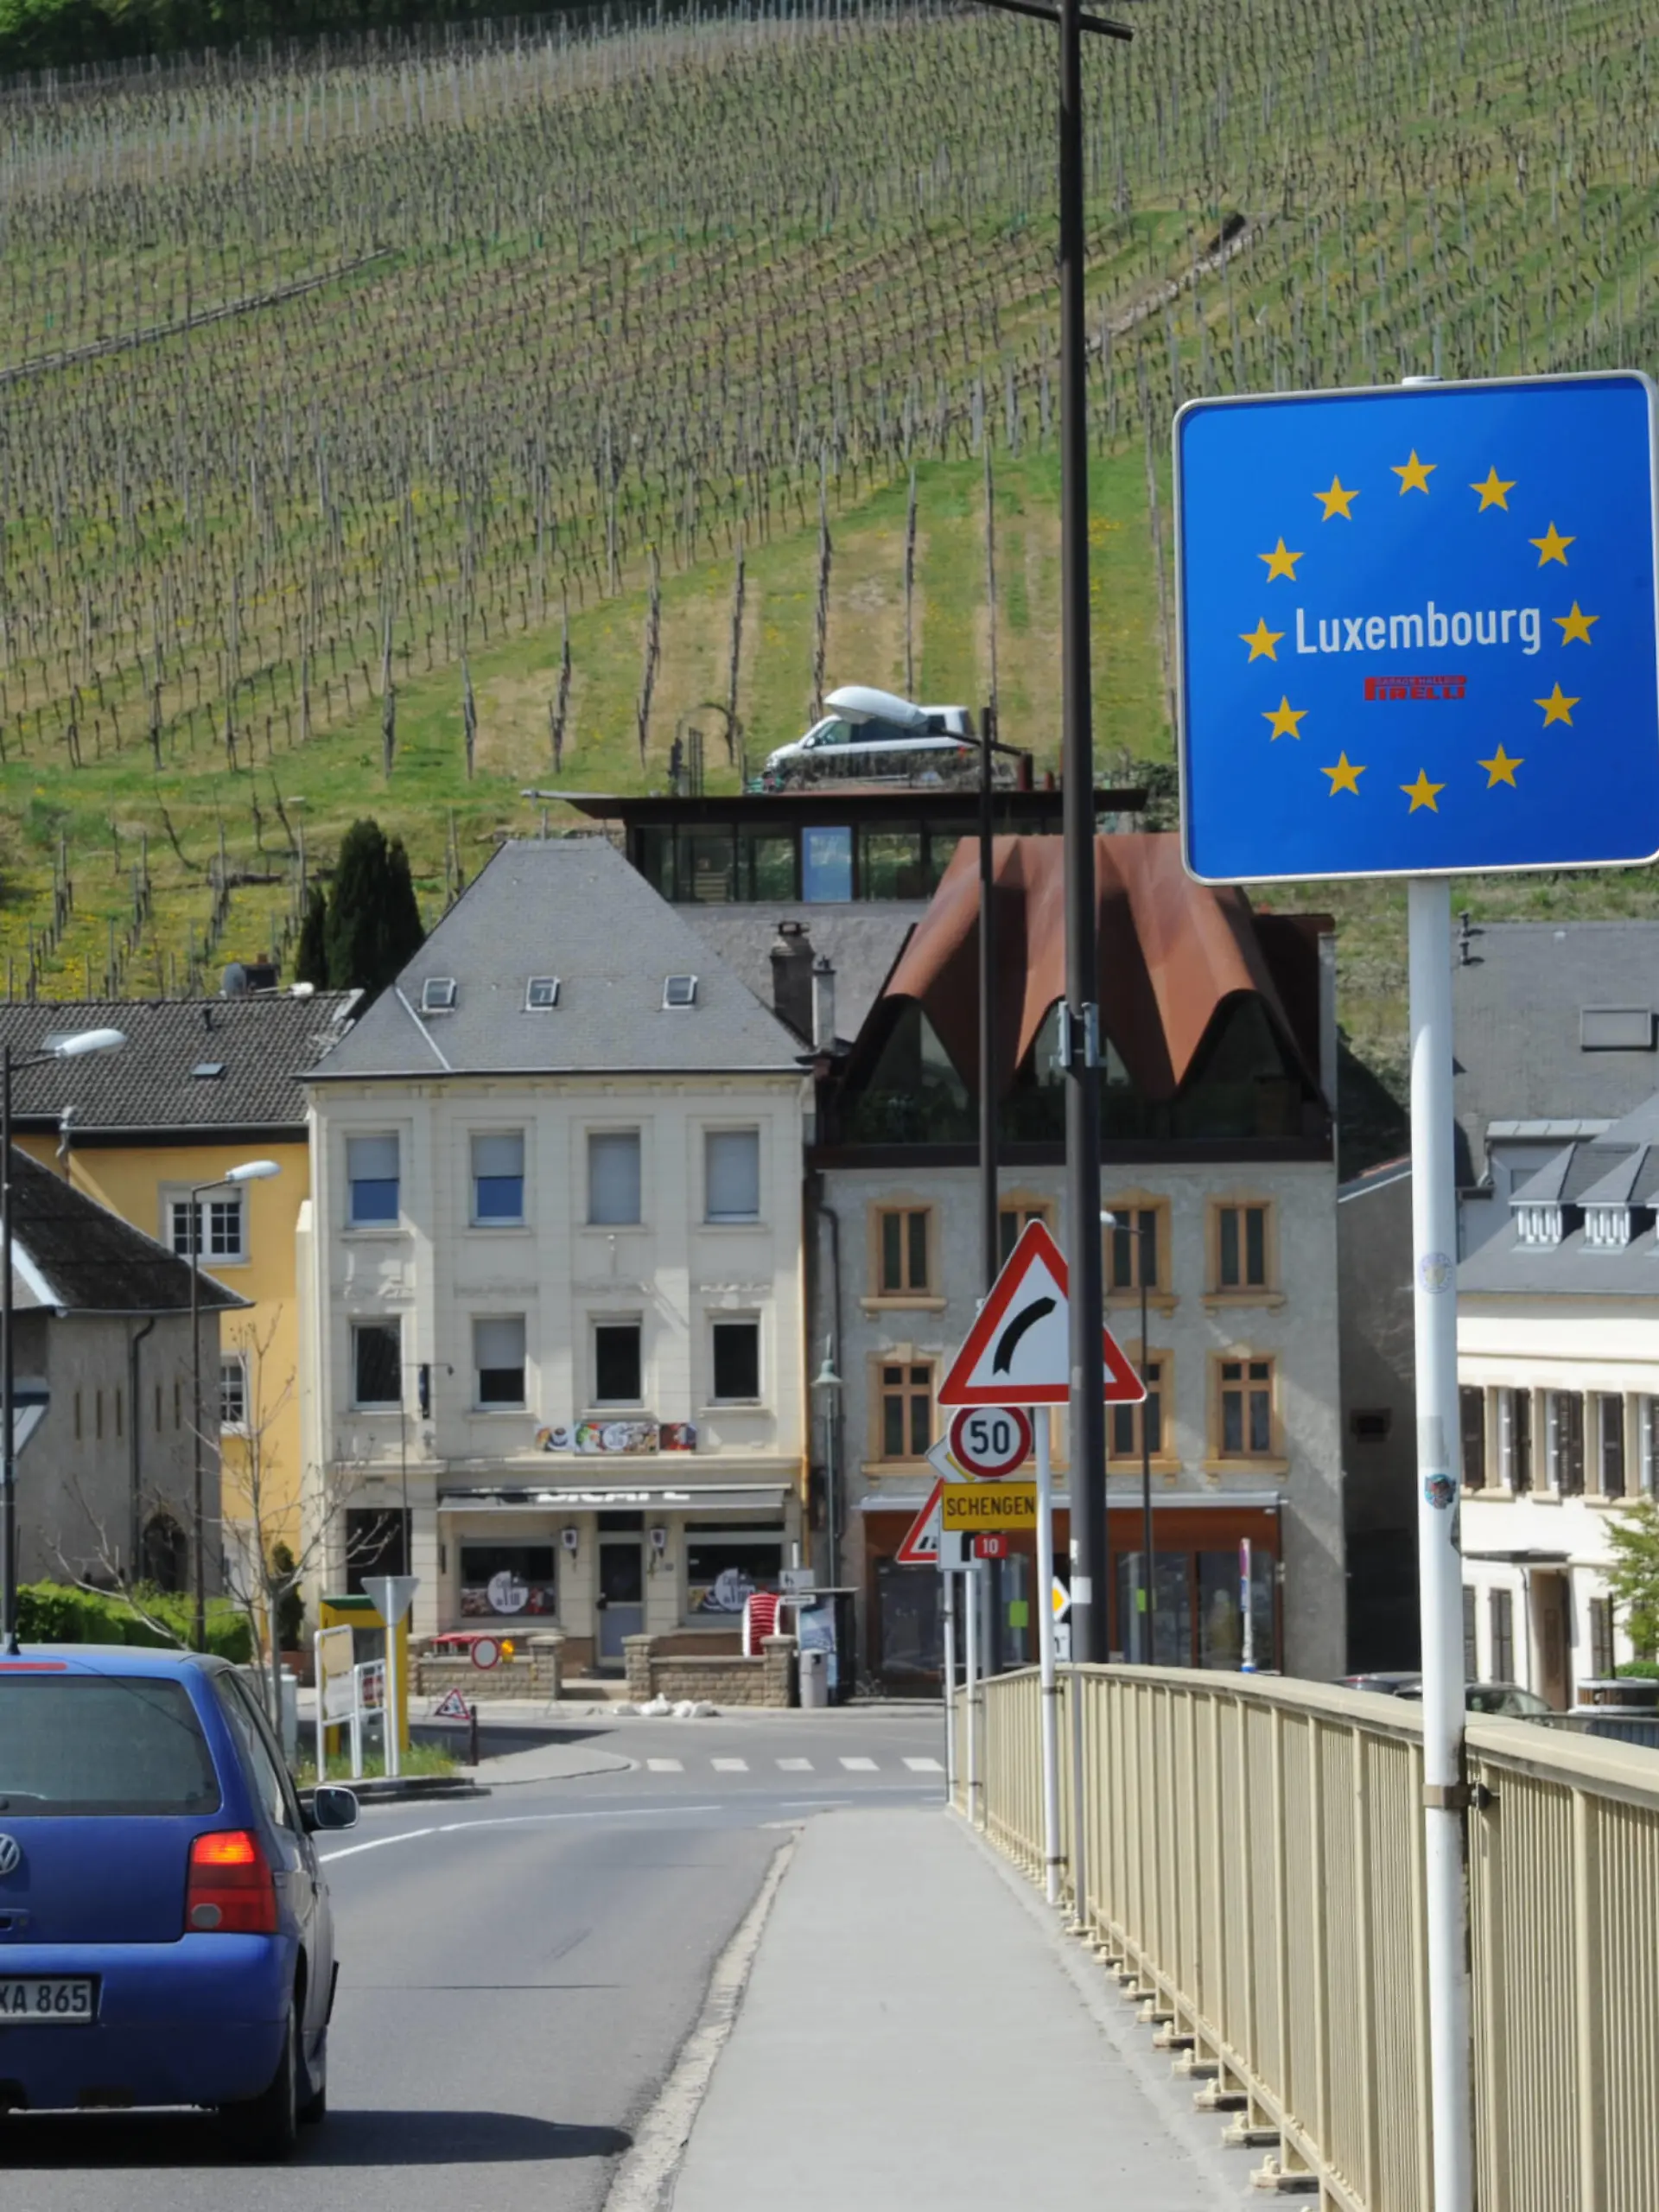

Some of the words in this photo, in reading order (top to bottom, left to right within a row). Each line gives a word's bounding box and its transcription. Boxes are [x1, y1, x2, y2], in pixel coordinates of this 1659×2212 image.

[1296, 601, 1541, 655] Luxembourg
[1364, 676, 1467, 701] PIRELLI
[970, 1420, 1010, 1455] 50
[946, 1496, 1035, 1516] SCHENGEN
[982, 1537, 999, 1554] 10
[36, 1985, 87, 2013] 865
